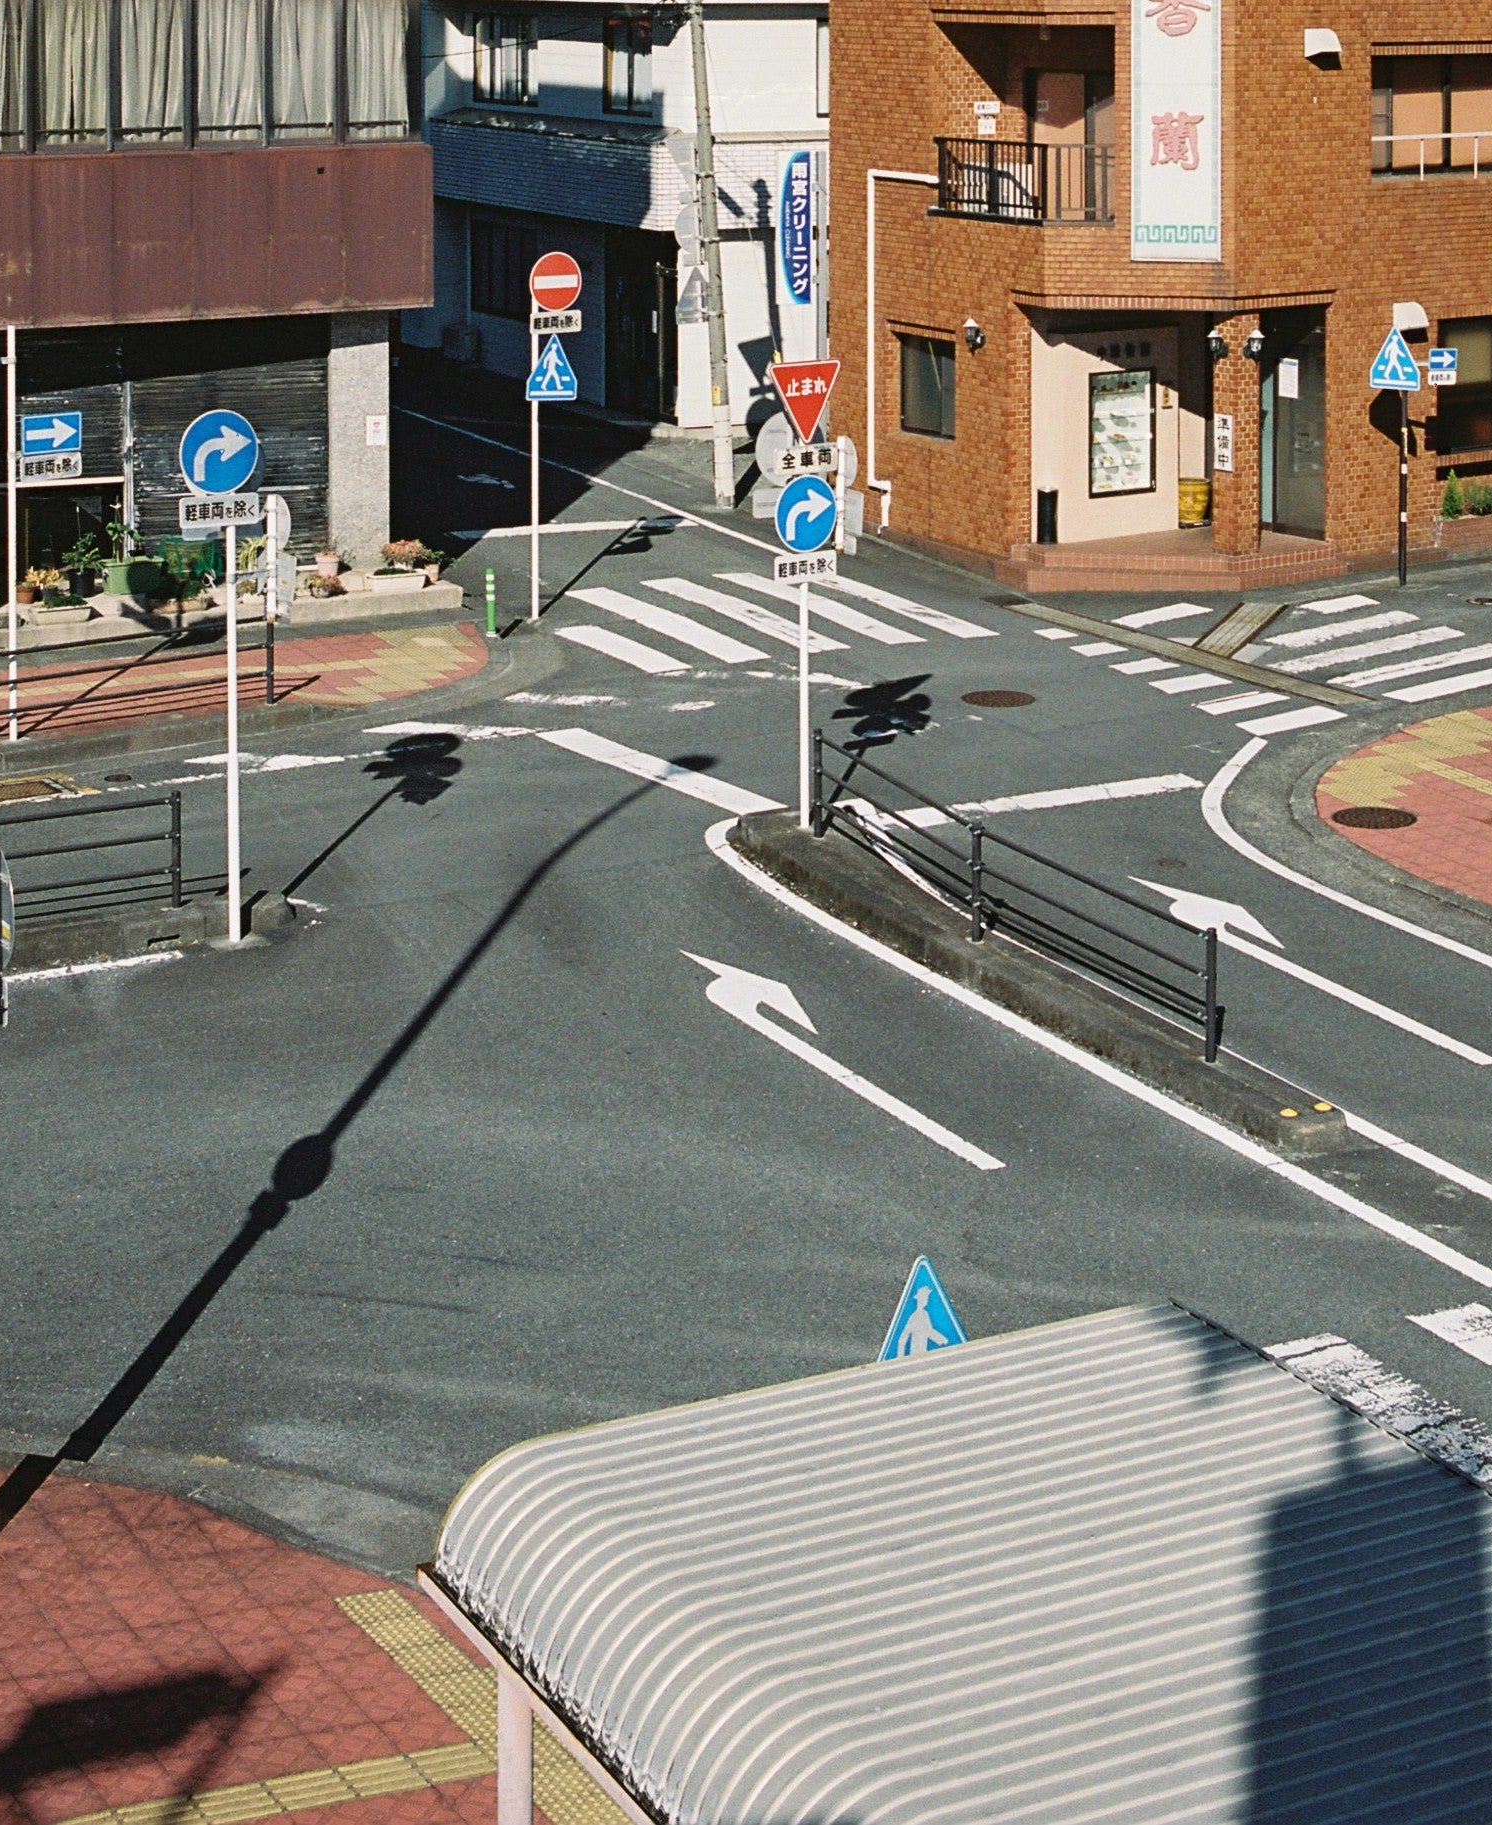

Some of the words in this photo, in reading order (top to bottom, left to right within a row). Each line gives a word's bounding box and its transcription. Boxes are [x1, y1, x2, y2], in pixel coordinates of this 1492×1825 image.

[791, 162, 809, 295] 雨宮クリーニング
[785, 377, 827, 397] 止まれ
[1217, 416, 1230, 468] 準備中
[24, 457, 78, 476] 軽車両を除く
[781, 448, 832, 470] 全車両
[185, 500, 256, 522] 軽車両を除く
[778, 557, 834, 578] 軽車両を除く
